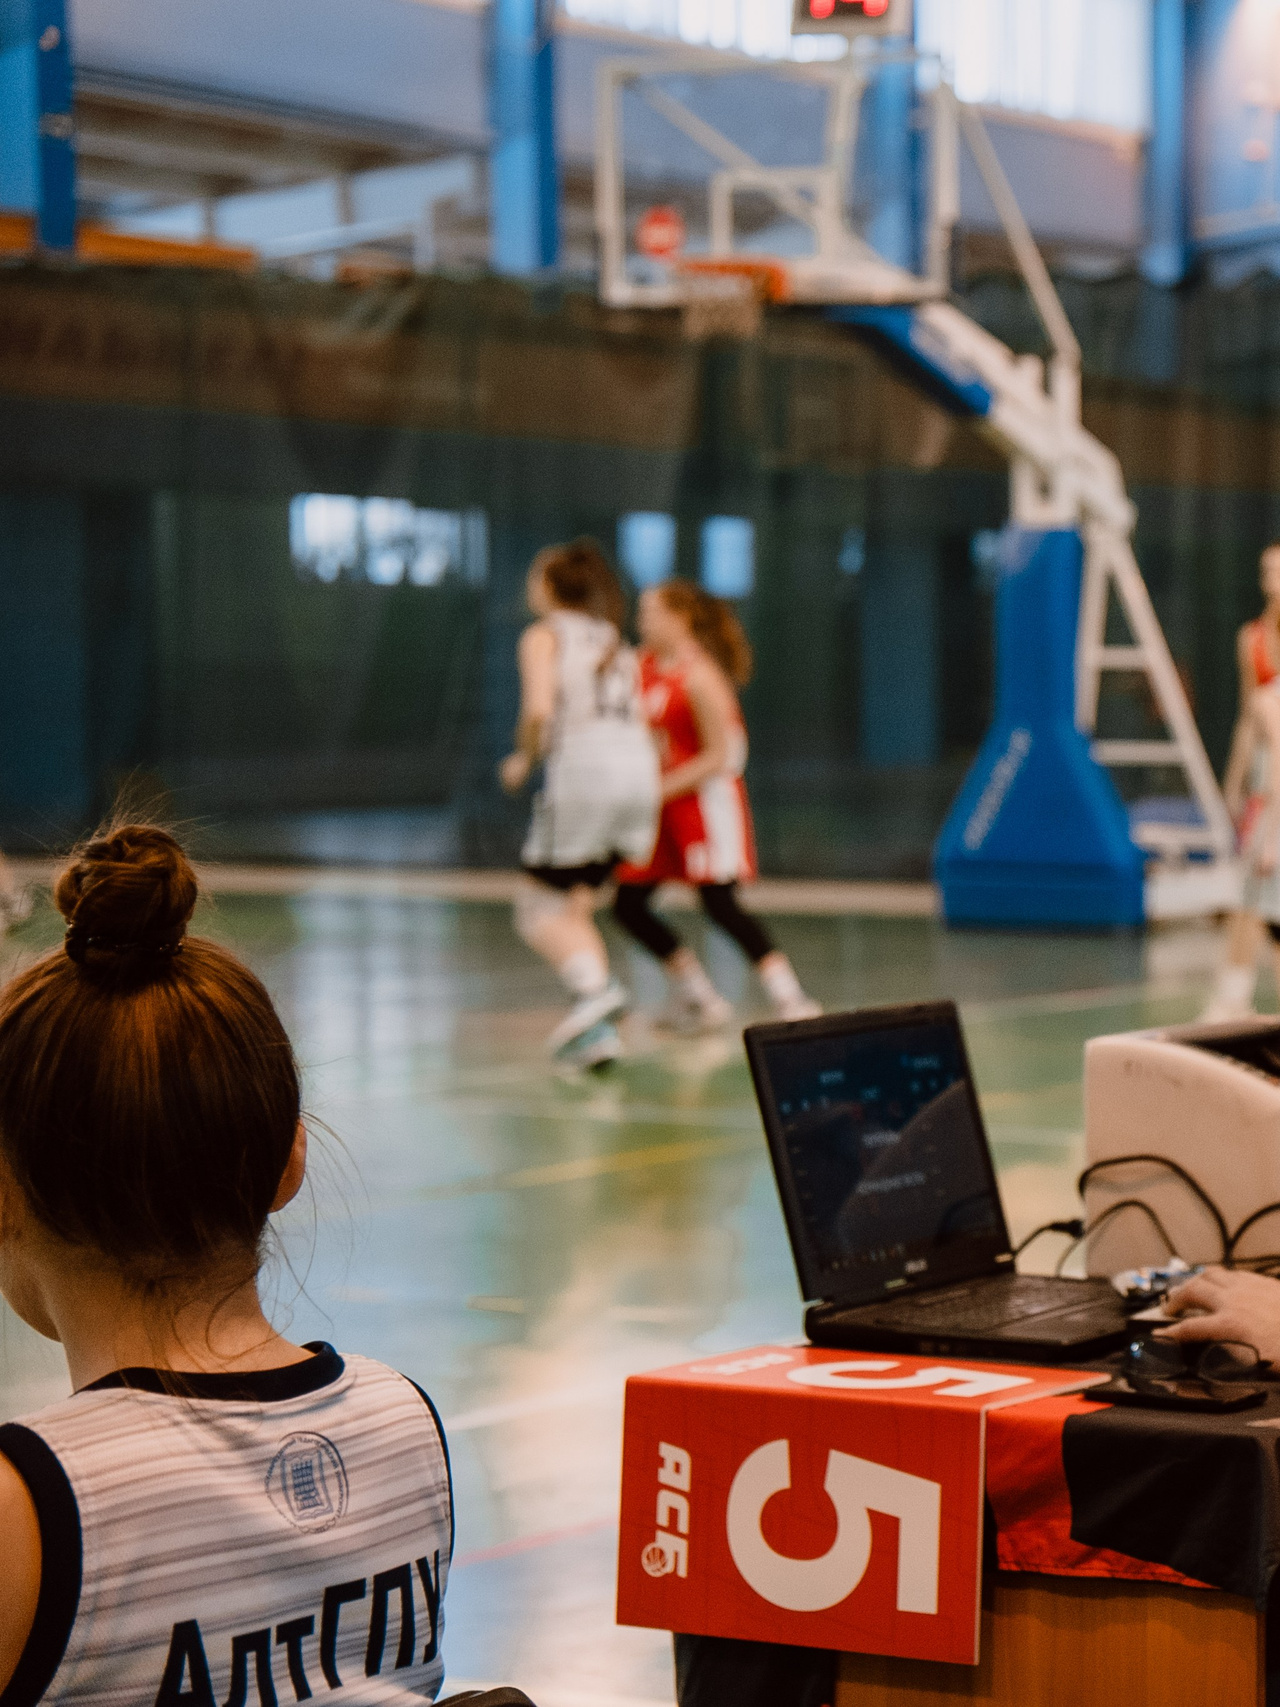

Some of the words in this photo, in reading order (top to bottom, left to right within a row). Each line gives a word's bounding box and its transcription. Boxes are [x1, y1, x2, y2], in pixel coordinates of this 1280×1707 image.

[787, 1360, 1034, 1397] 5
[648, 1441, 692, 1579] АСБ
[726, 1438, 942, 1615] 5
